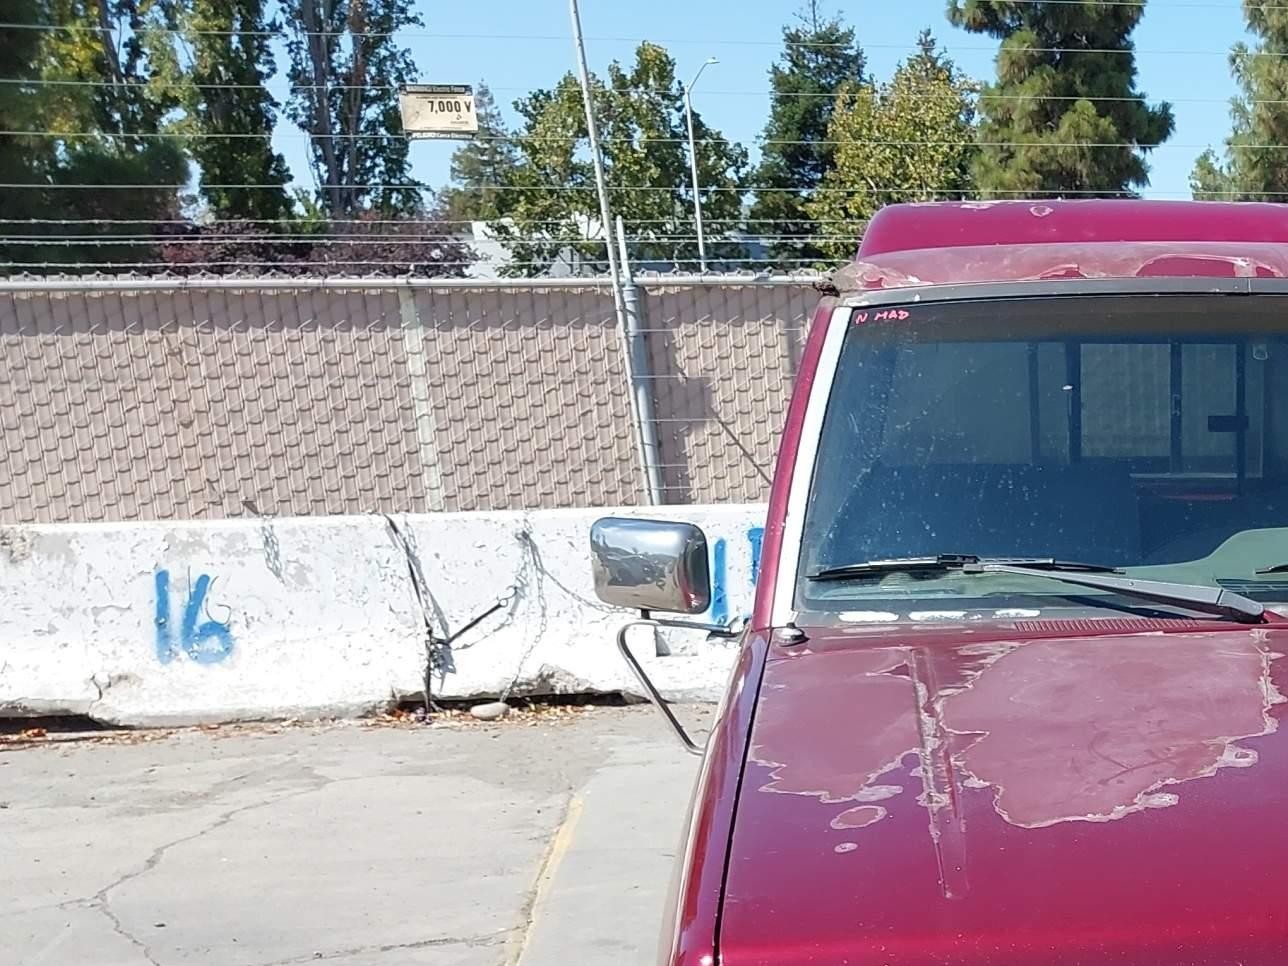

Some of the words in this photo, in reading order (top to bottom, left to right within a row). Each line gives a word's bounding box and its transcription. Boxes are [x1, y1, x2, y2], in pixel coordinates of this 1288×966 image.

[427, 101, 461, 114] 7,000
[464, 101, 471, 112] V
[154, 568, 234, 666] 16
